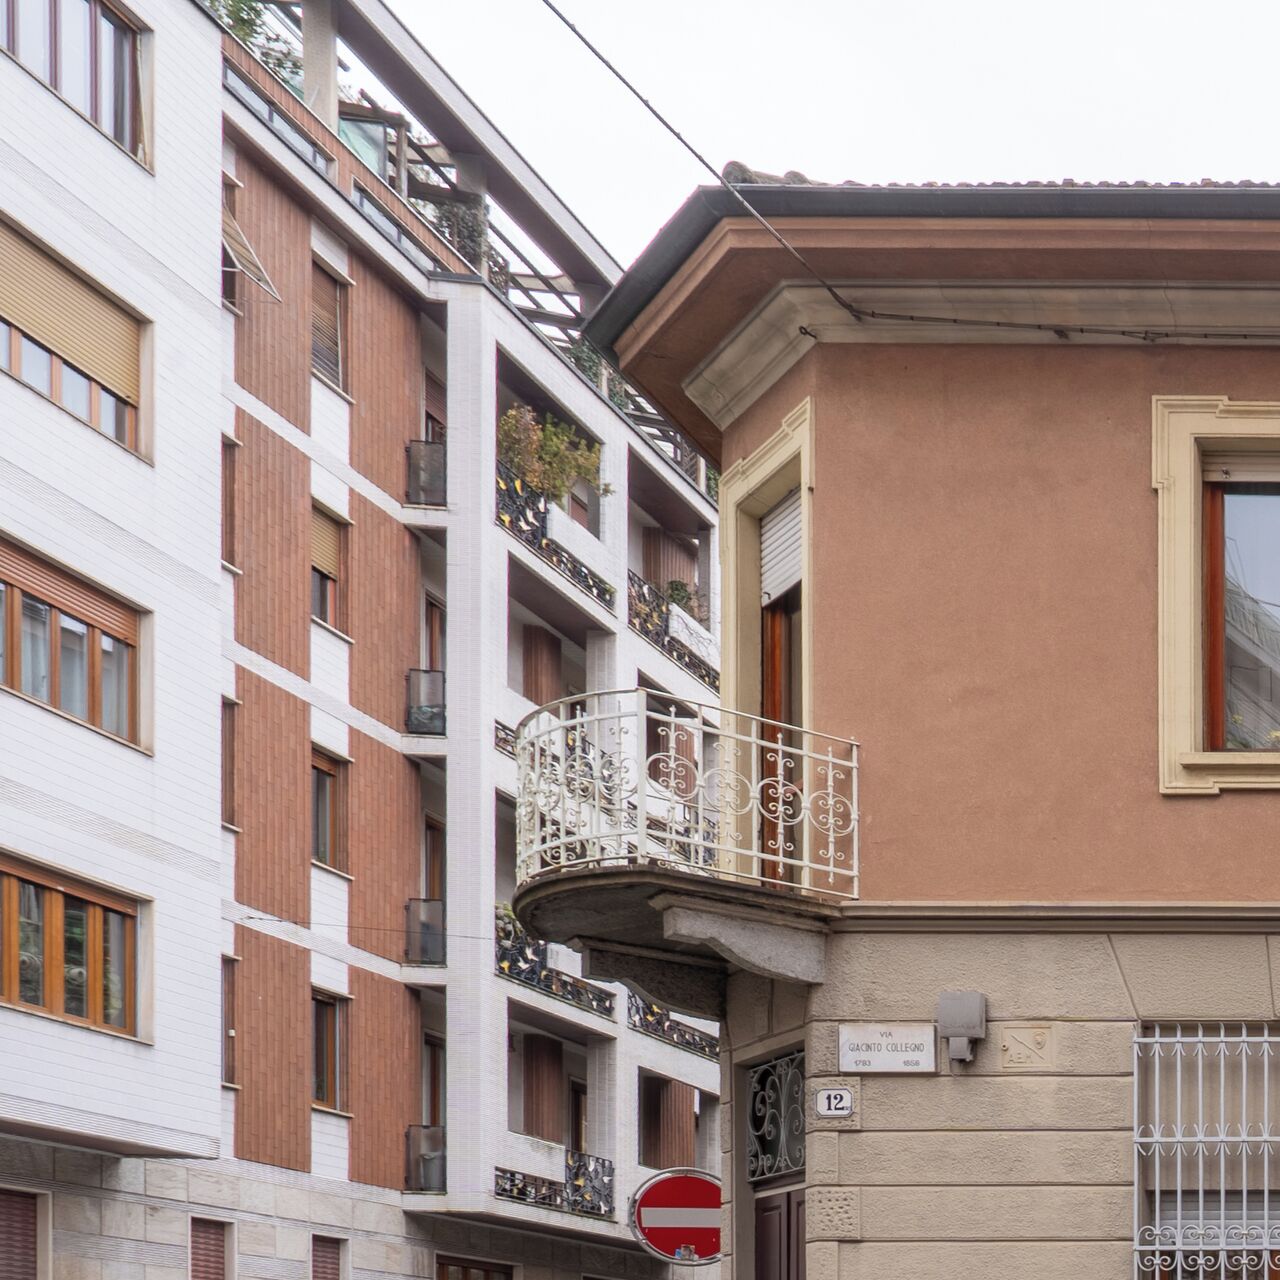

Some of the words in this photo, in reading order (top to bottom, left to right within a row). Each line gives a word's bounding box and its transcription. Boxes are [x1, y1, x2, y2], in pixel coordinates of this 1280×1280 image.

[879, 1031, 893, 1039] VIA
[848, 1043, 882, 1052] GIACINTO
[886, 1043, 924, 1052] COLLEGNO
[826, 1093, 845, 1111] 12
